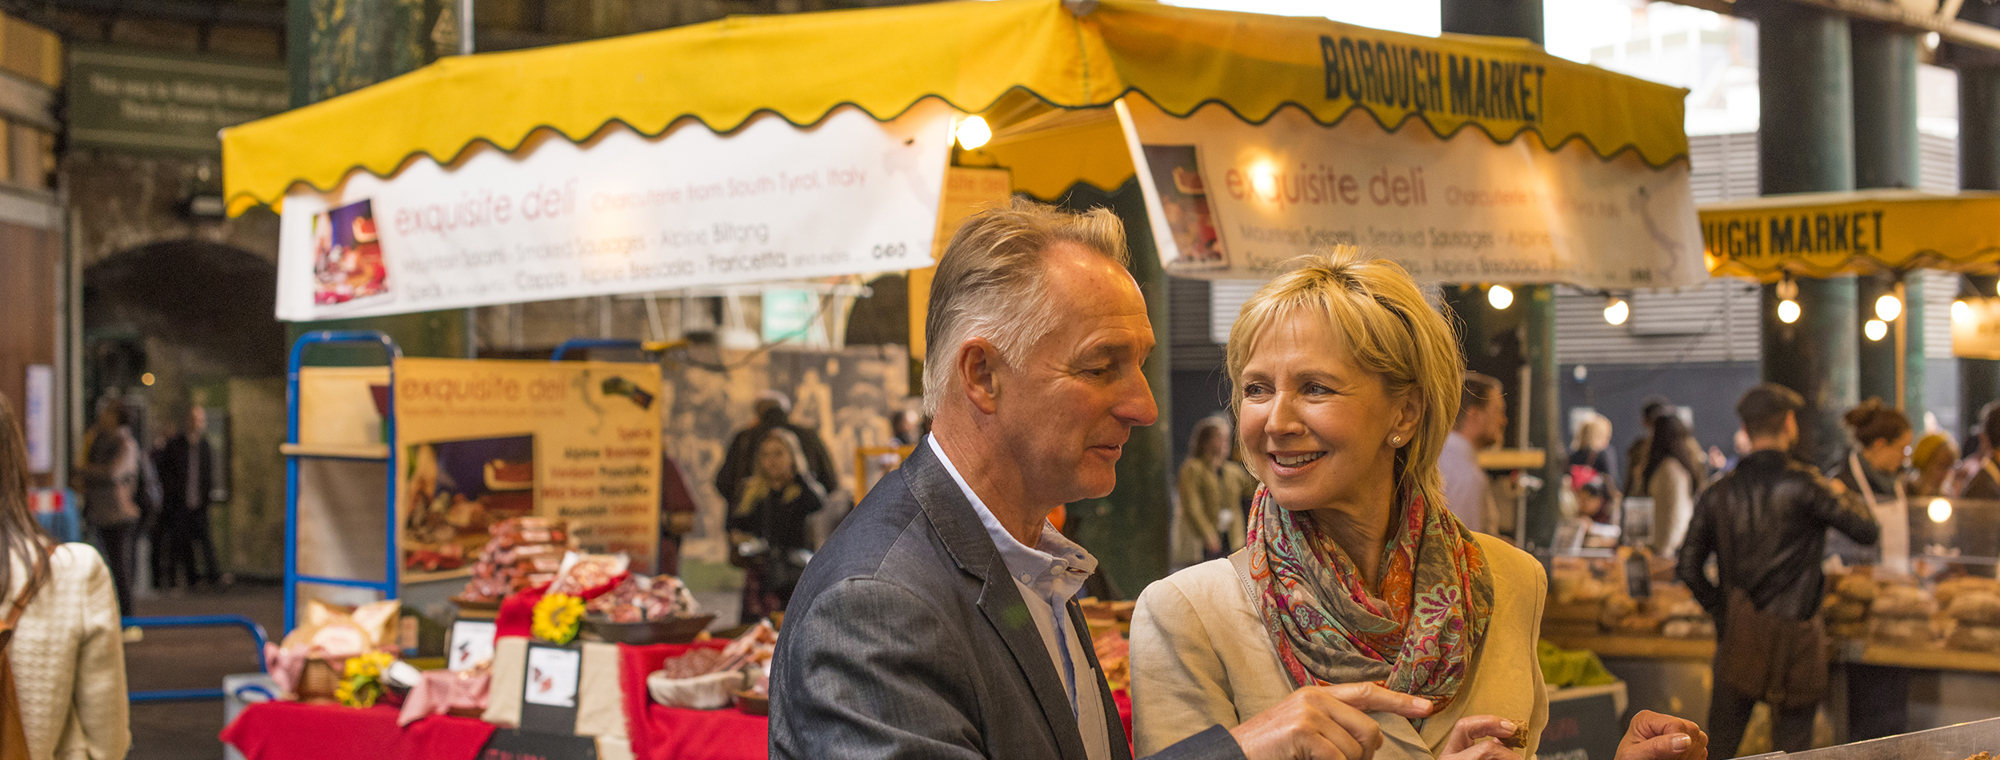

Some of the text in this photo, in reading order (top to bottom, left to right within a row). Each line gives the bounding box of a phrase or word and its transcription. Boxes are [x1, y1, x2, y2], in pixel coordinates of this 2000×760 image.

[1319, 34, 1546, 123] BOROUGH MARKET
[394, 189, 513, 240] exquisite
[520, 176, 579, 222] deli
[726, 175, 775, 199] South
[827, 164, 868, 190] Italy
[1369, 165, 1428, 208] deli
[1769, 210, 1884, 255] MARKET
[401, 371, 568, 403] exquisite deli
